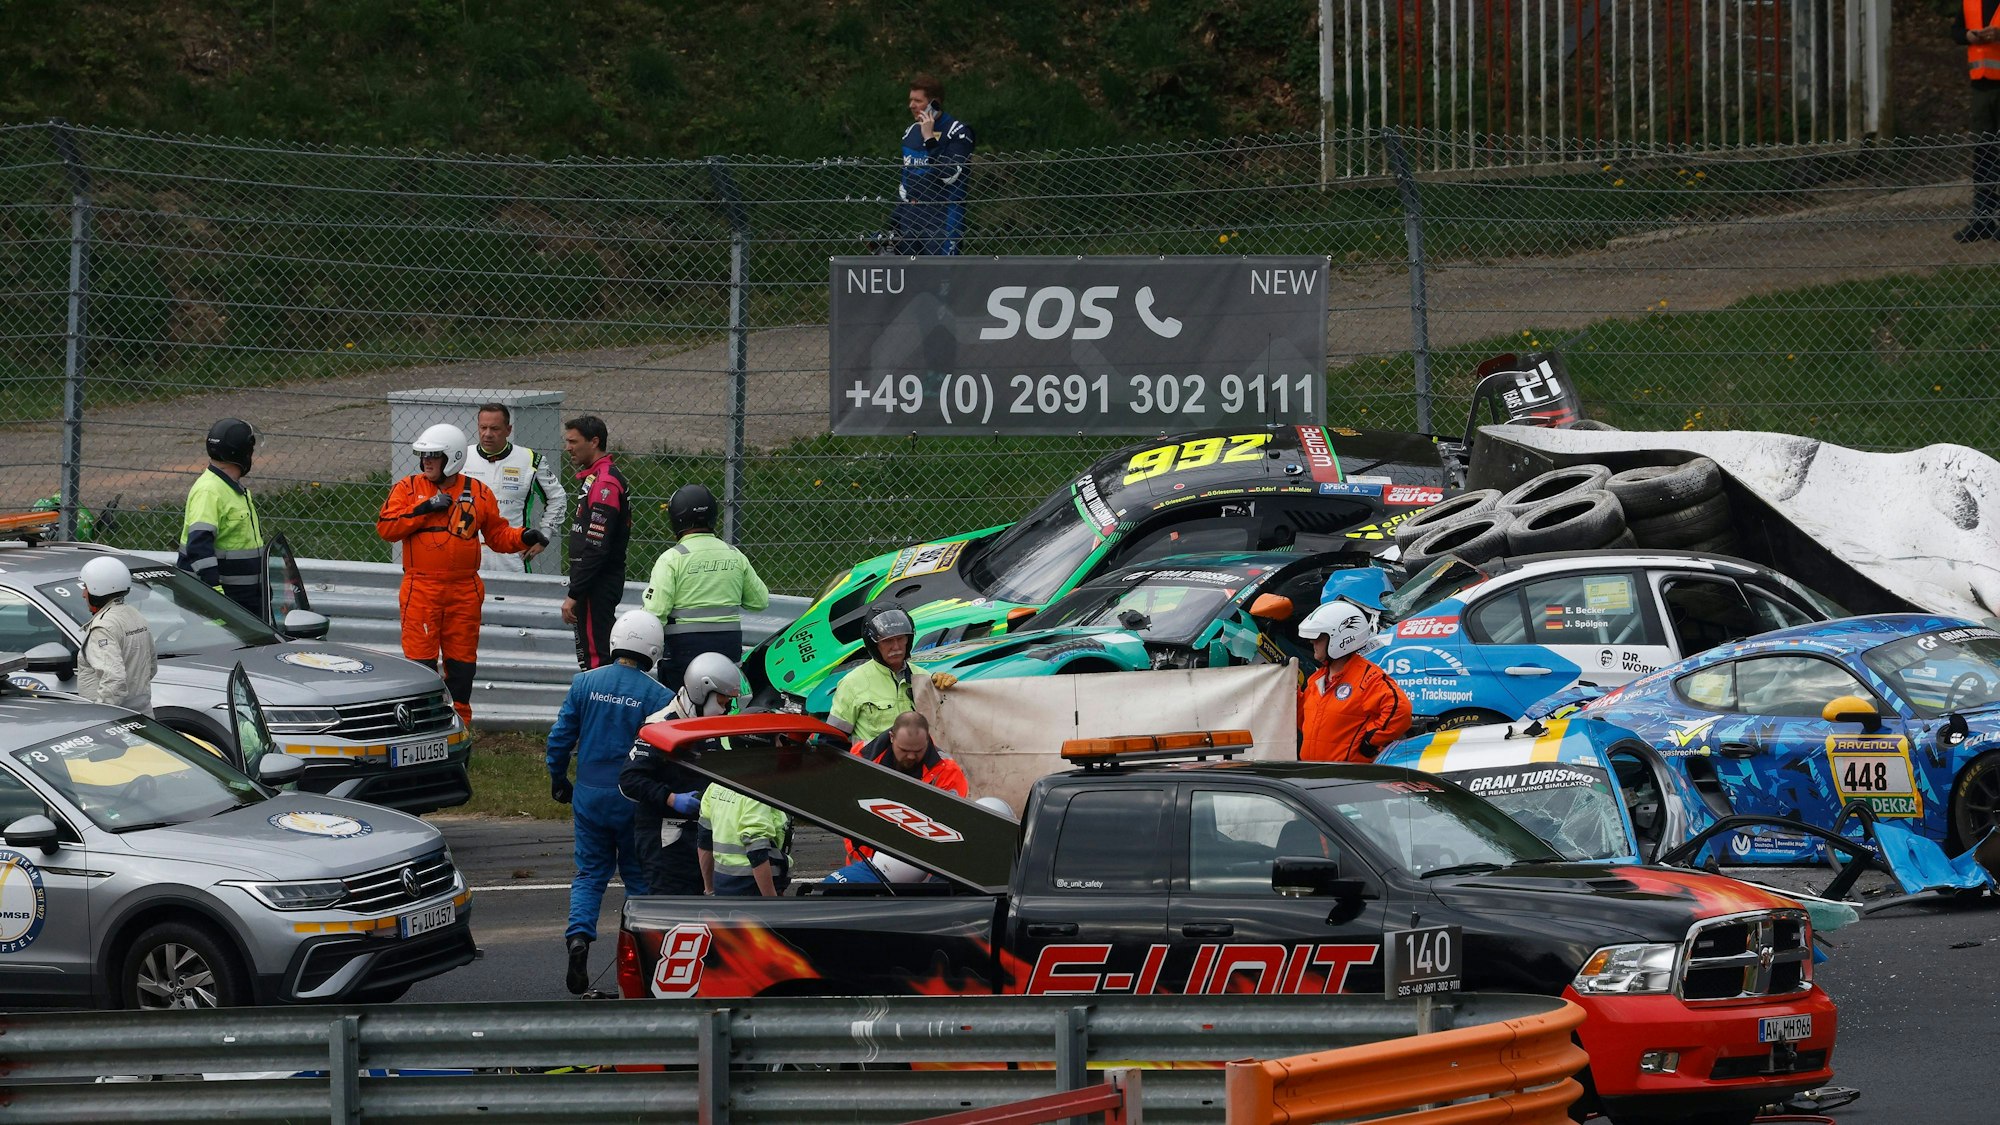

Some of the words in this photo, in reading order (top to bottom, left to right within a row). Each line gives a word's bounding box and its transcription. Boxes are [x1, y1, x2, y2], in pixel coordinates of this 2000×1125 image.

[846, 268, 905, 294] NEU
[1250, 269, 1317, 295] NEW
[979, 285, 1120, 340] SOS
[845, 374, 923, 414] +49
[939, 374, 994, 424] (0)
[1009, 374, 1109, 414] 2691
[1129, 374, 1205, 414] 302
[1220, 374, 1314, 414] 9111
[1301, 427, 1332, 467] WEMPE
[1122, 433, 1274, 486] 992
[1387, 492, 1443, 502] auto
[1391, 487, 1420, 495] sport
[132, 570, 176, 580] STAFFEL
[54, 587, 71, 598] 9
[1576, 606, 1606, 614] Becker
[1400, 622, 1459, 635] auto
[1405, 617, 1436, 628] sport
[1564, 620, 1573, 628] J.
[1575, 620, 1609, 629] Spölgen
[1622, 652, 1641, 663] DR.
[1384, 658, 1411, 674] JS
[1622, 661, 1661, 675] WORK
[589, 691, 624, 705] Medical
[625, 697, 642, 708] Car
[1421, 688, 1473, 703] Tracksupport
[105, 721, 147, 737] STAFFEL
[50, 735, 94, 754] DMSB
[1838, 741, 1895, 750] RAVENOL
[30, 751, 49, 763] 8
[1469, 774, 1520, 792] GRAN
[1521, 769, 1594, 785] TURISMO
[1844, 762, 1887, 792] 448
[1960, 762, 1983, 798] EAGLE
[1510, 786, 1543, 794] DRIVING
[1544, 781, 1592, 789] SIMULATOR
[1872, 797, 1917, 813] DEKRA
[18, 857, 39, 881] TEAM
[1056, 878, 1104, 889] @e_unit_safety
[37, 903, 45, 920] 1972
[651, 923, 713, 999] 8
[1406, 930, 1451, 976] 140
[1398, 985, 1411, 996] SOS
[1411, 983, 1422, 994] +49
[1423, 983, 1437, 994] 2691
[1437, 981, 1449, 992] 302
[1449, 980, 1461, 991] 9111
[1796, 1017, 1811, 1036] 966
